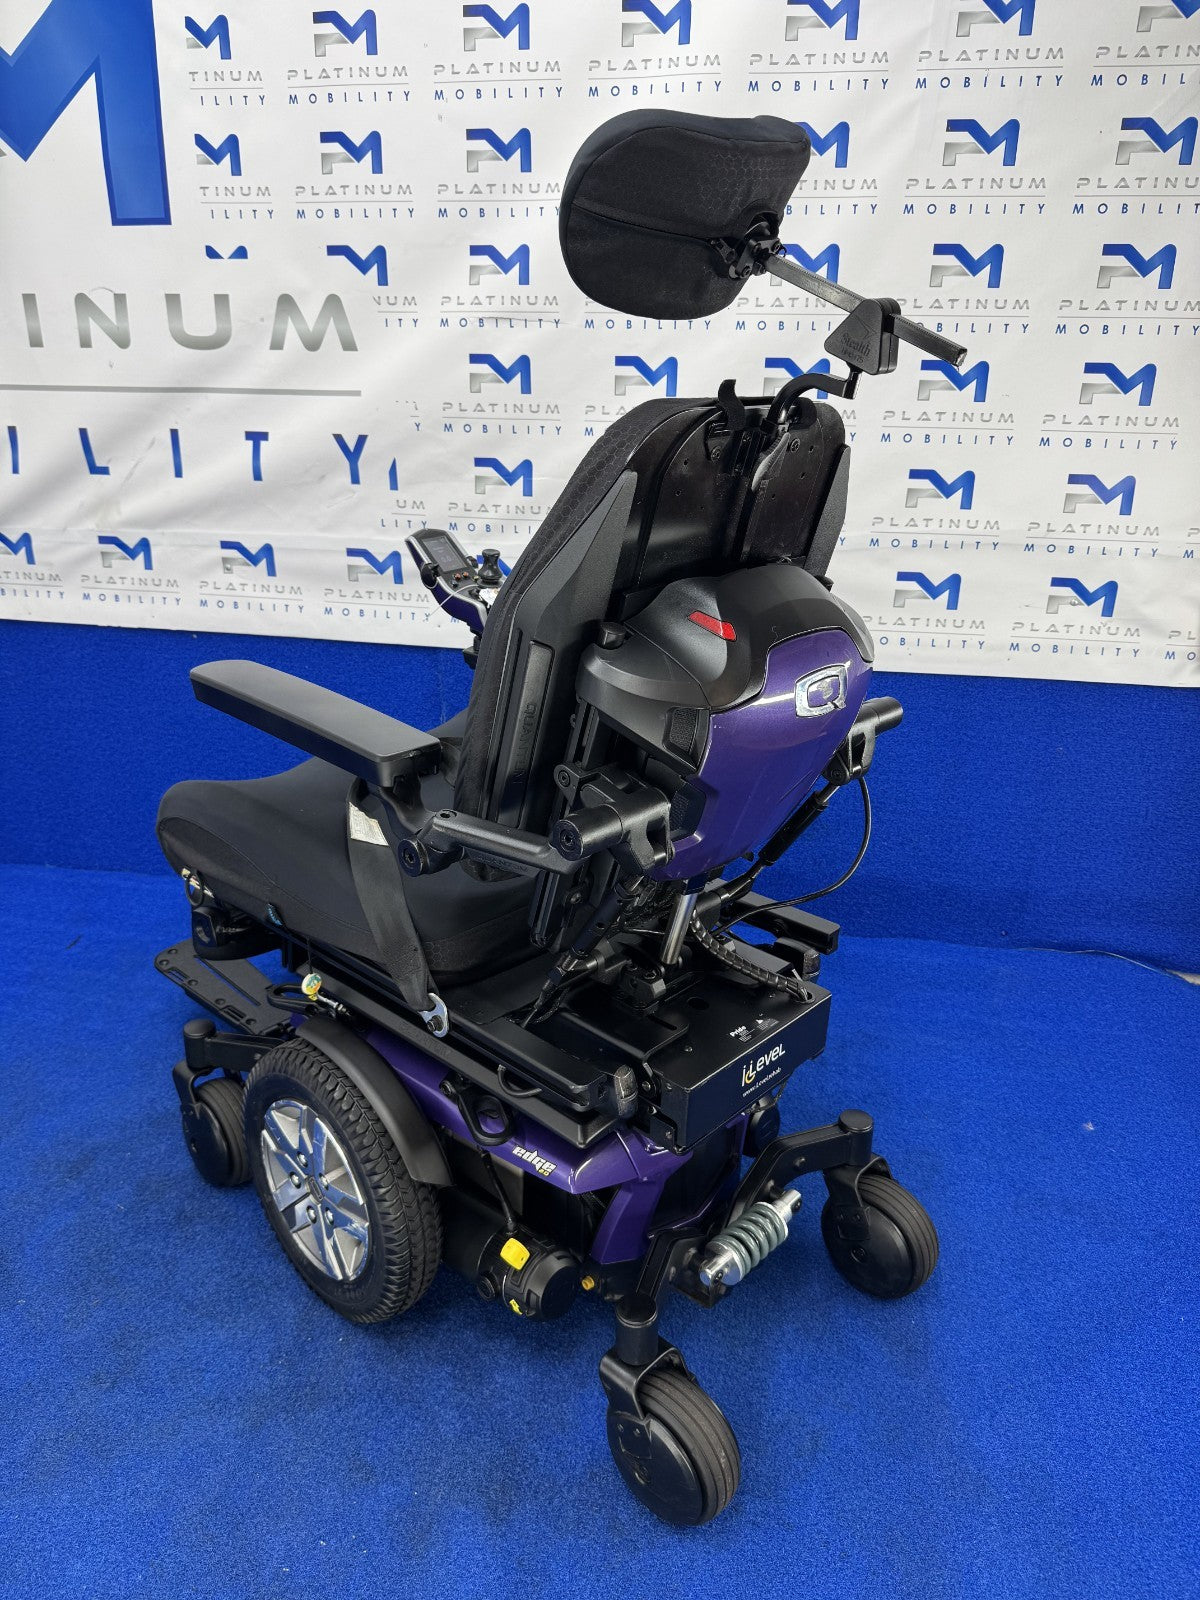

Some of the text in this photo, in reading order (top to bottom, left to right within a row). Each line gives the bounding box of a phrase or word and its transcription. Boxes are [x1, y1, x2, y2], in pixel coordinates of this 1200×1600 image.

[750, 50, 889, 66] PLATINUM
[918, 47, 1064, 63] PLATINUM
[433, 60, 561, 76] PLATINUM
[588, 54, 721, 72] PLATINUM
[287, 65, 409, 81] PLATINUM
[589, 80, 722, 98] MOBILITY
[748, 78, 889, 92] MOBILITY
[915, 75, 1064, 89] MOBILITY
[288, 91, 410, 105] MOBILITY
[434, 86, 563, 101] MOBILITY
[295, 184, 413, 197] PLATINUM
[437, 182, 561, 195] PLATINUM
[905, 177, 1047, 190] PLATINUM
[297, 207, 414, 219] MOBILITY
[903, 203, 1046, 215] MOBILITY
[441, 295, 559, 306] PLATINUM
[440, 317, 561, 329] MOBILITY
[584, 319, 711, 330] MOBILITY
[442, 402, 561, 414] PLATINUM
[883, 410, 1015, 424] PLATINUM
[1042, 414, 1180, 428] PLATINUM
[443, 422, 562, 436] MOBILITY
[880, 432, 1014, 446] MOBILITY
[1038, 437, 1178, 450] MOBILITY
[871, 516, 1001, 531] PLATINUM
[1027, 521, 1160, 537] PLATINUM
[869, 538, 1000, 551] MOBILITY
[1023, 543, 1159, 558] MOBILITY
[80, 574, 180, 588] PLATINUM
[199, 580, 303, 596] PLATINUM
[82, 592, 181, 606] MOBILITY
[323, 588, 430, 603] PLATINUM
[200, 598, 305, 614] MOBILITY
[1011, 621, 1141, 638] PLATINUM
[1009, 642, 1141, 658] MOBILITY
